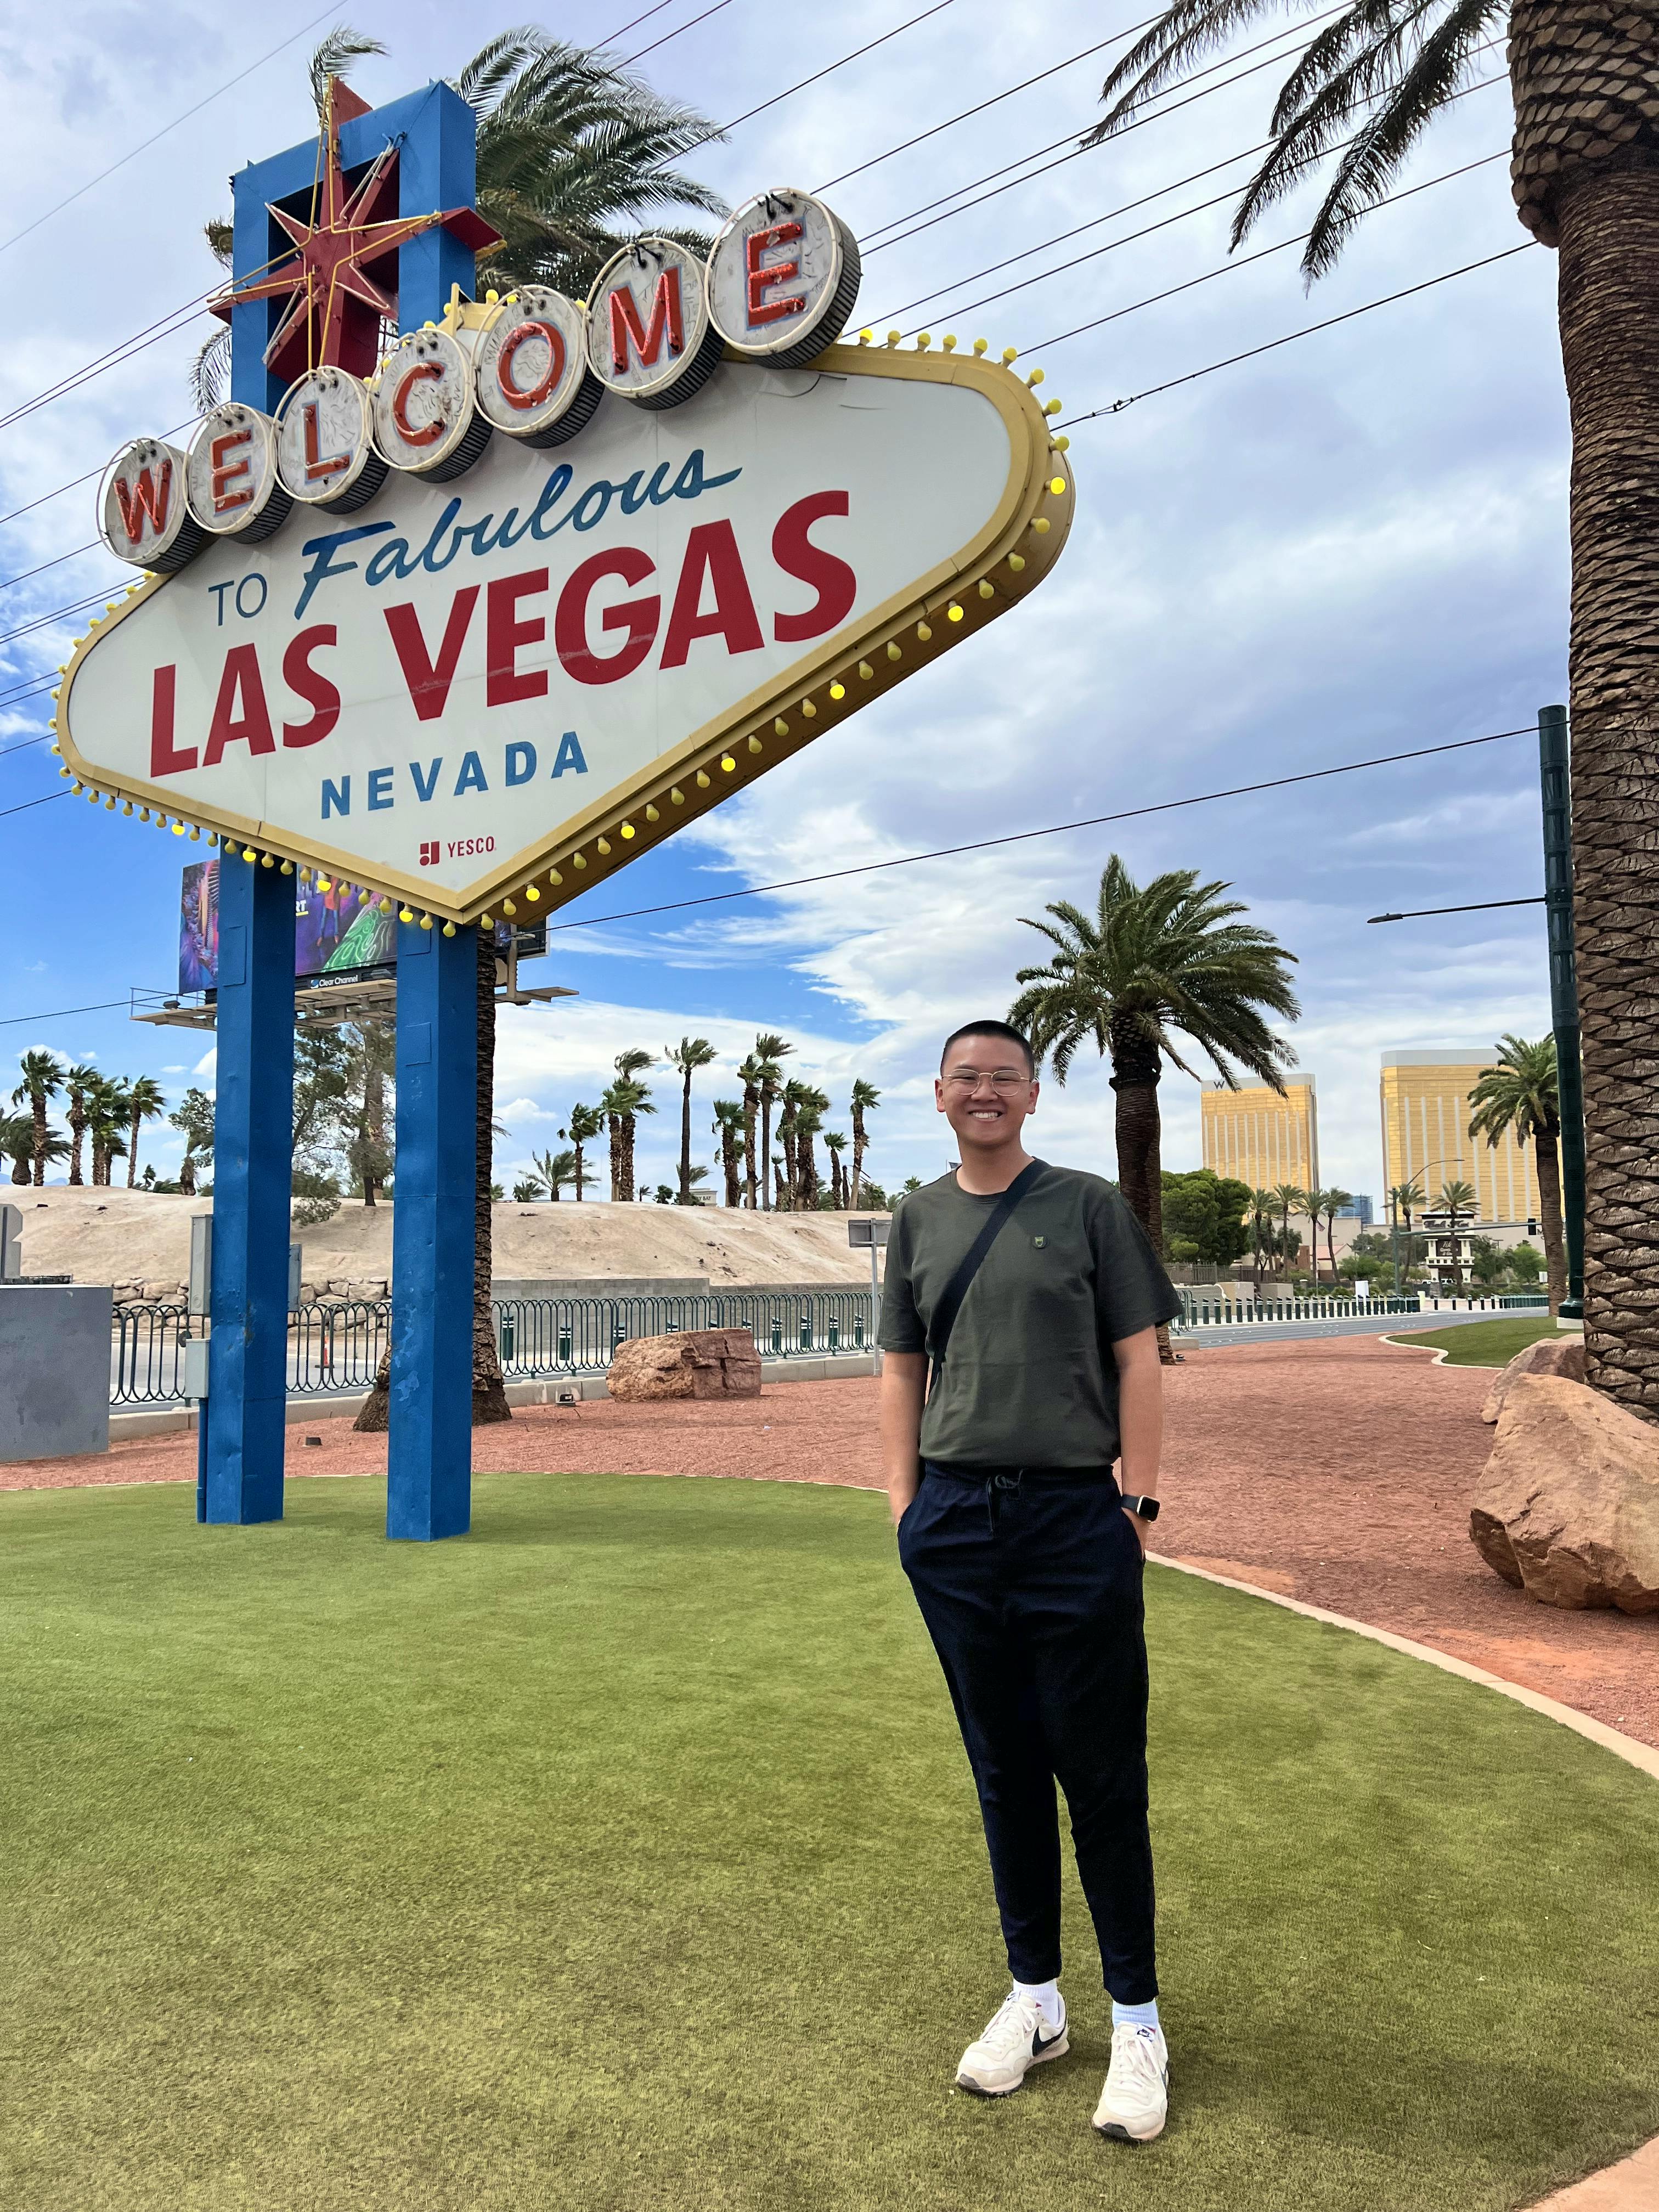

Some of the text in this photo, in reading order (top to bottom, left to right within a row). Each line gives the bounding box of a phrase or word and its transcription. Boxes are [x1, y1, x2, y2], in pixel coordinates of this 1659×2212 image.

[112, 216, 807, 545] WELCOME
[208, 449, 743, 627] TO Fabulous
[150, 490, 857, 778] LAS VEGAS
[321, 731, 589, 820] NEVADA
[447, 836, 495, 858] YESCO
[319, 974, 358, 987] Clear Channel
[1214, 1081, 1224, 1090] W
